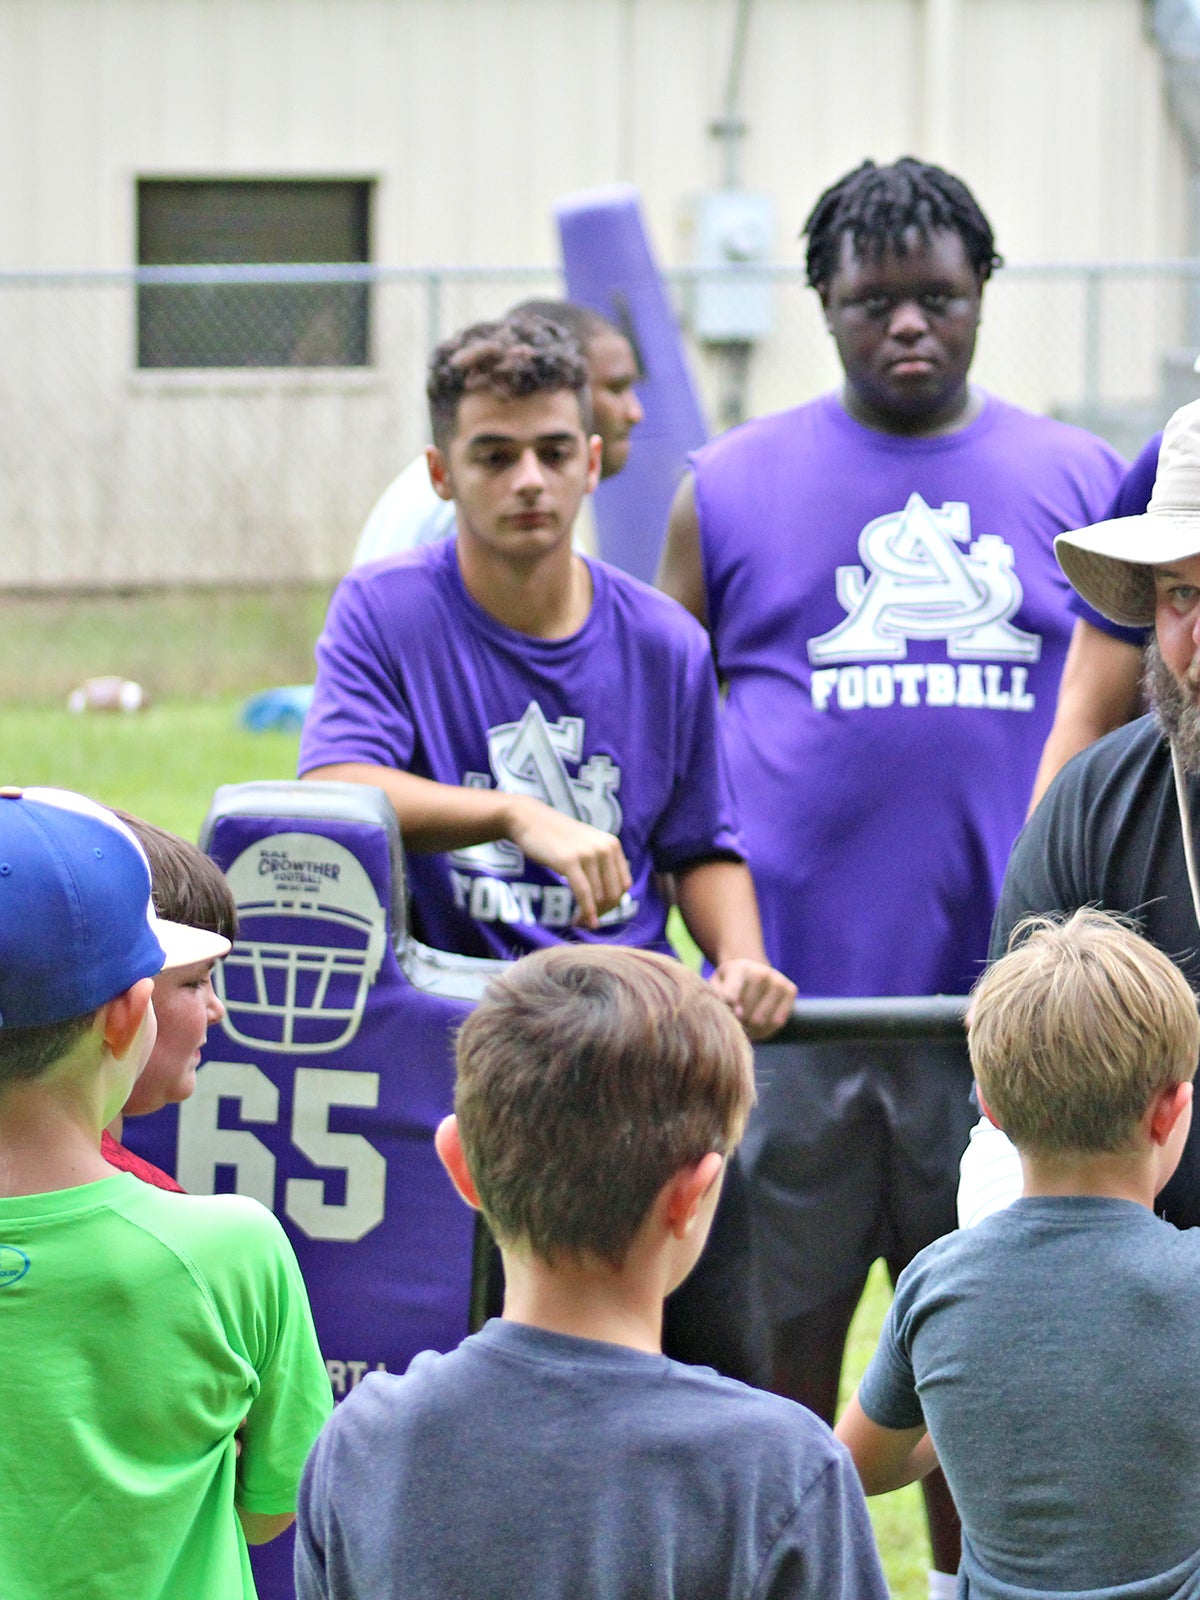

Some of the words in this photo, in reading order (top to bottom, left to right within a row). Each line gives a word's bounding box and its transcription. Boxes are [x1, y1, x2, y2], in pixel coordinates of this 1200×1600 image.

[810, 663, 1036, 712] FOOTBALL
[258, 858, 341, 883] CROWTHER
[176, 1061, 388, 1243] 65
